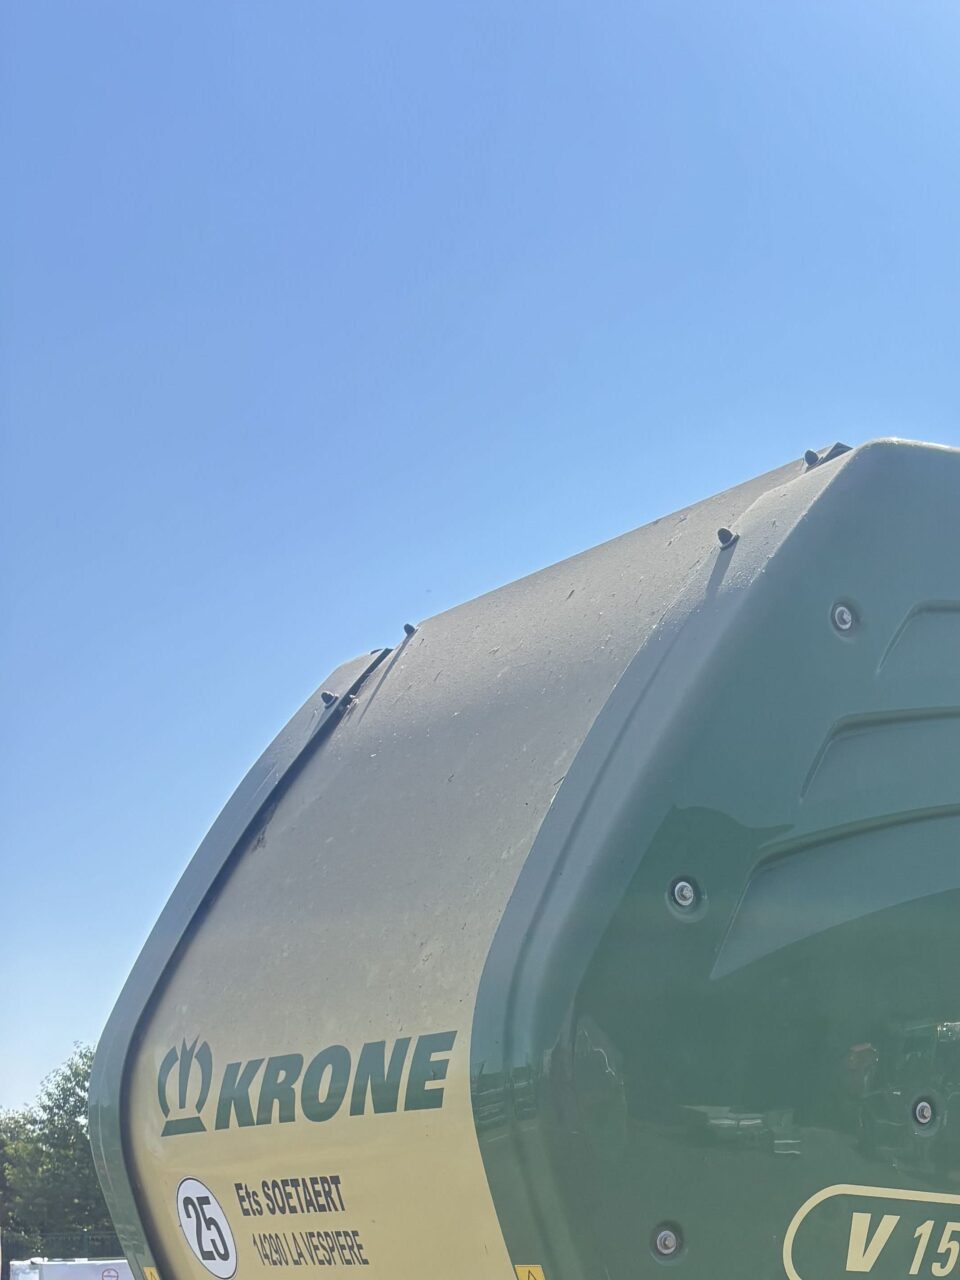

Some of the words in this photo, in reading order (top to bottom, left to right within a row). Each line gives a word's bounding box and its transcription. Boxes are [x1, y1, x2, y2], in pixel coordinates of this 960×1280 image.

[214, 1030, 458, 1131] KRONE
[234, 1182, 263, 1217] Ets
[261, 1175, 346, 1216] SOETAERT
[182, 1196, 230, 1262] 25
[252, 1232, 289, 1266] 14290
[283, 1232, 308, 1266] LA
[300, 1230, 370, 1265] VESPIERE
[845, 1212, 901, 1273] V
